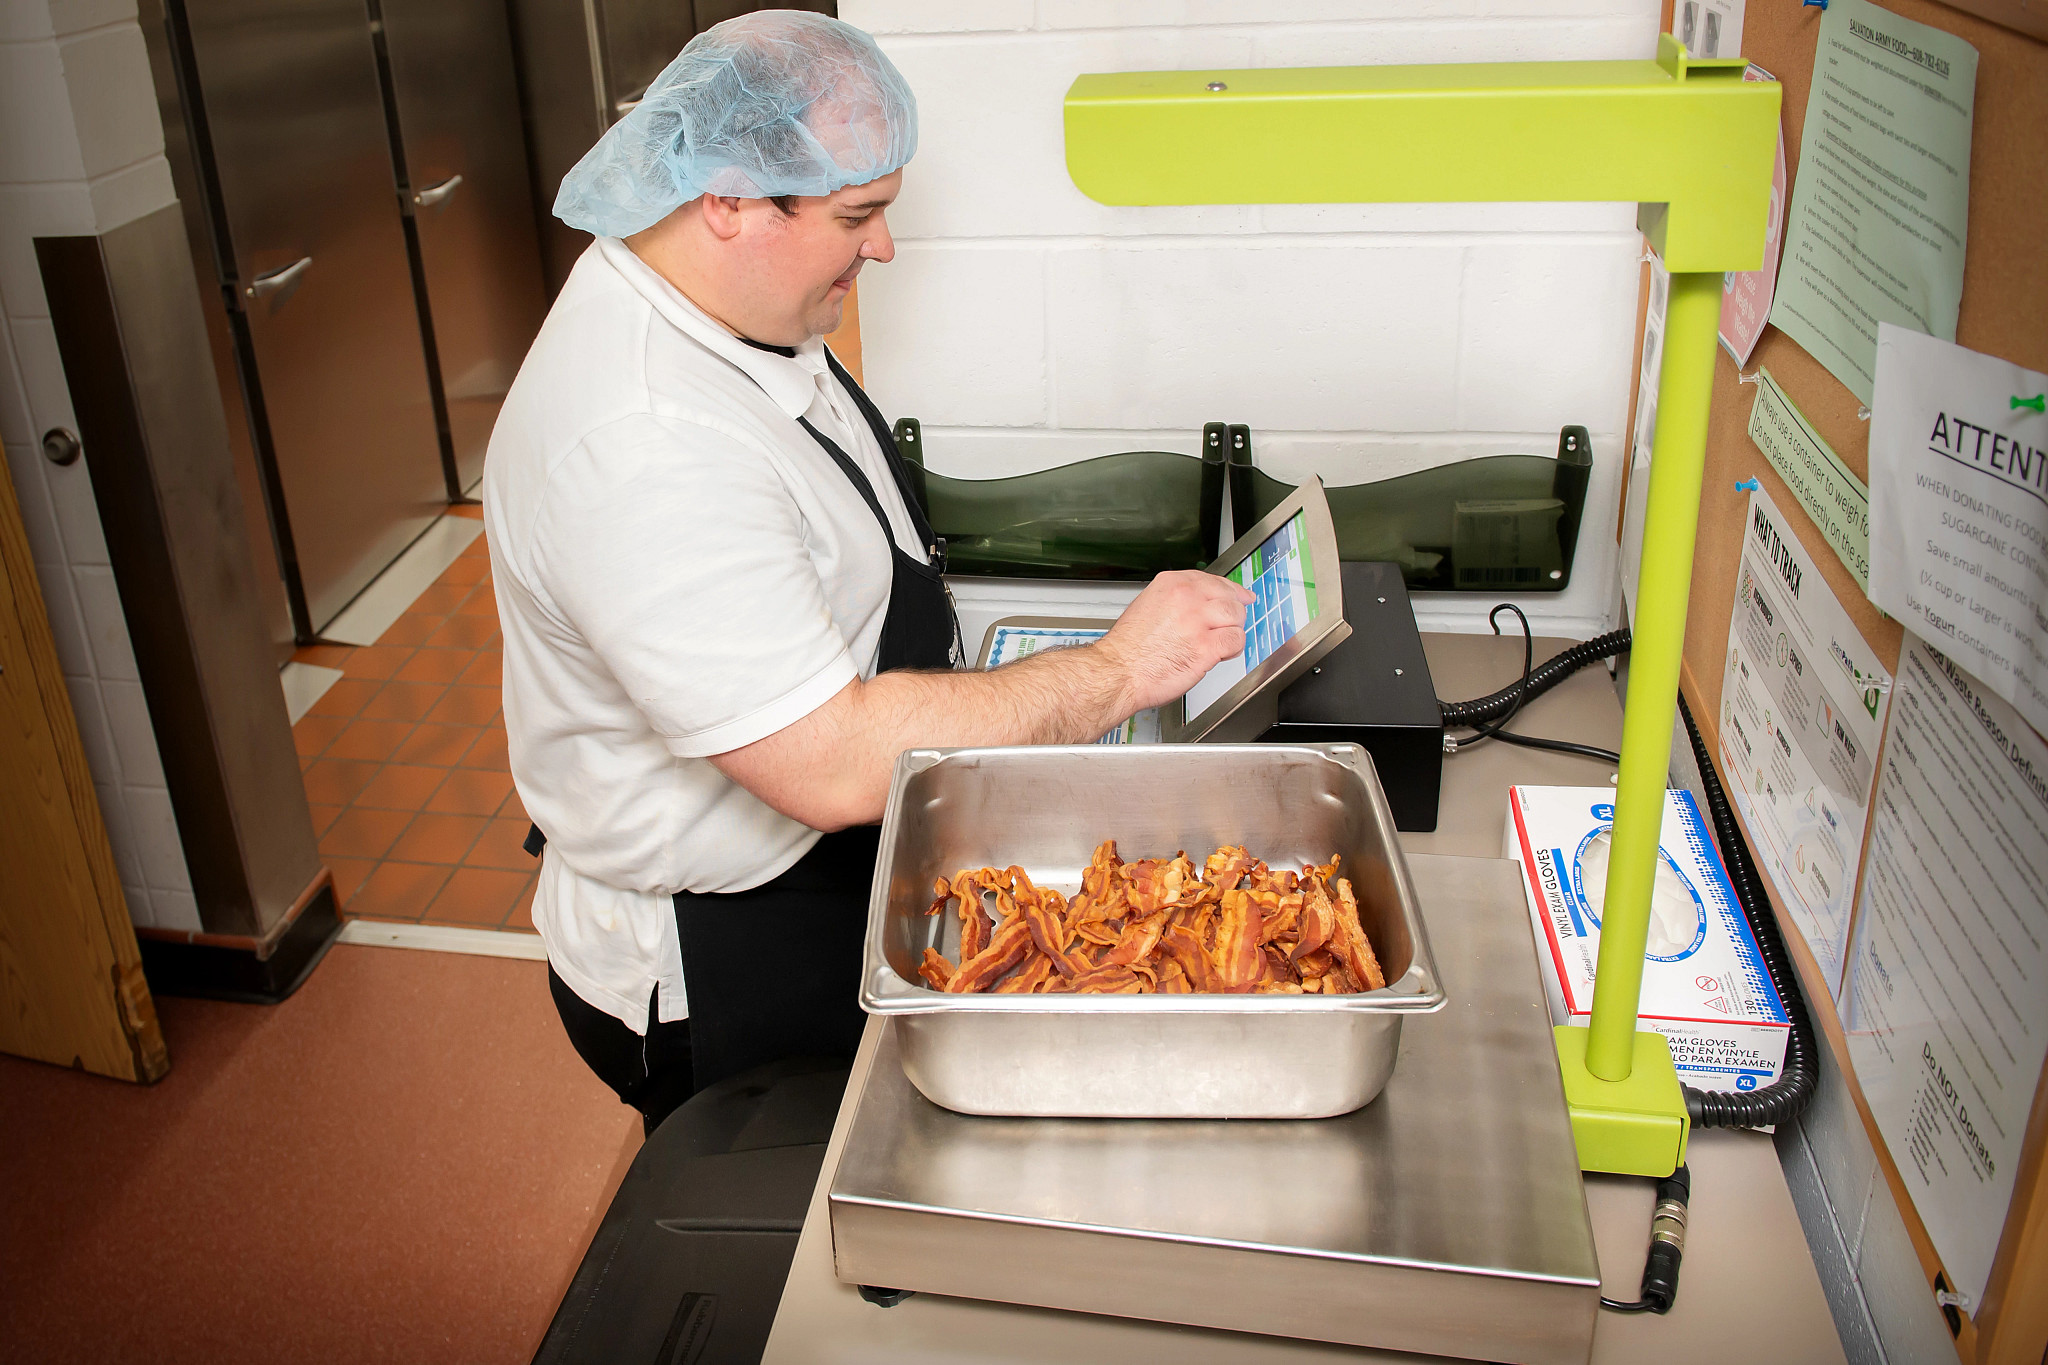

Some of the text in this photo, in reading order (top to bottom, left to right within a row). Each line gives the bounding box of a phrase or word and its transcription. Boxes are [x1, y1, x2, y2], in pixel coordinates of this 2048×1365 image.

[1850, 19, 1874, 40] SALVATION
[1875, 32, 1891, 47] ARMY
[1760, 390, 1869, 538] Always use a container to weigh fo
[1930, 411, 2048, 494] ATTENT
[1754, 416, 1869, 580] Do not place food directly on the sca
[1916, 472, 2042, 546] WHEN DONATING FOOD
[1753, 502, 1803, 601] WHAT TO TRACK
[1941, 512, 2008, 555] SUGARCANE
[1927, 539, 2028, 605] Save small amounts
[1935, 580, 1953, 599] cup
[1954, 592, 1966, 606] or
[1968, 597, 2002, 626] Larger
[2003, 618, 2012, 634] is
[1831, 634, 1855, 676] LeanPath
[1906, 593, 1922, 614] Use
[1924, 604, 1956, 637] Yogurt
[1957, 629, 2010, 672] containers
[1945, 657, 1973, 703] Waste
[1974, 695, 2009, 752] Reason
[2010, 742, 2048, 807] Definiti
[1599, 806, 1614, 819] XL
[1536, 848, 1573, 939] VINYL EXAM GLOVES
[1564, 891, 1575, 906] CLEAR
[1870, 940, 1894, 996] Donate
[1655, 1027, 1700, 1035] CardinalHealth
[1744, 1000, 1758, 1016] 130
[1667, 1037, 1737, 1048] AM GLOVES
[1669, 1045, 1760, 1059] MEN EN VINYLE
[1672, 1054, 1776, 1069] LO PARA EXAMEN
[1686, 1065, 1741, 1074] TRANSPARENTES
[1740, 1079, 1753, 1087] XL
[1922, 1040, 1996, 1174] Do NOT Donate
